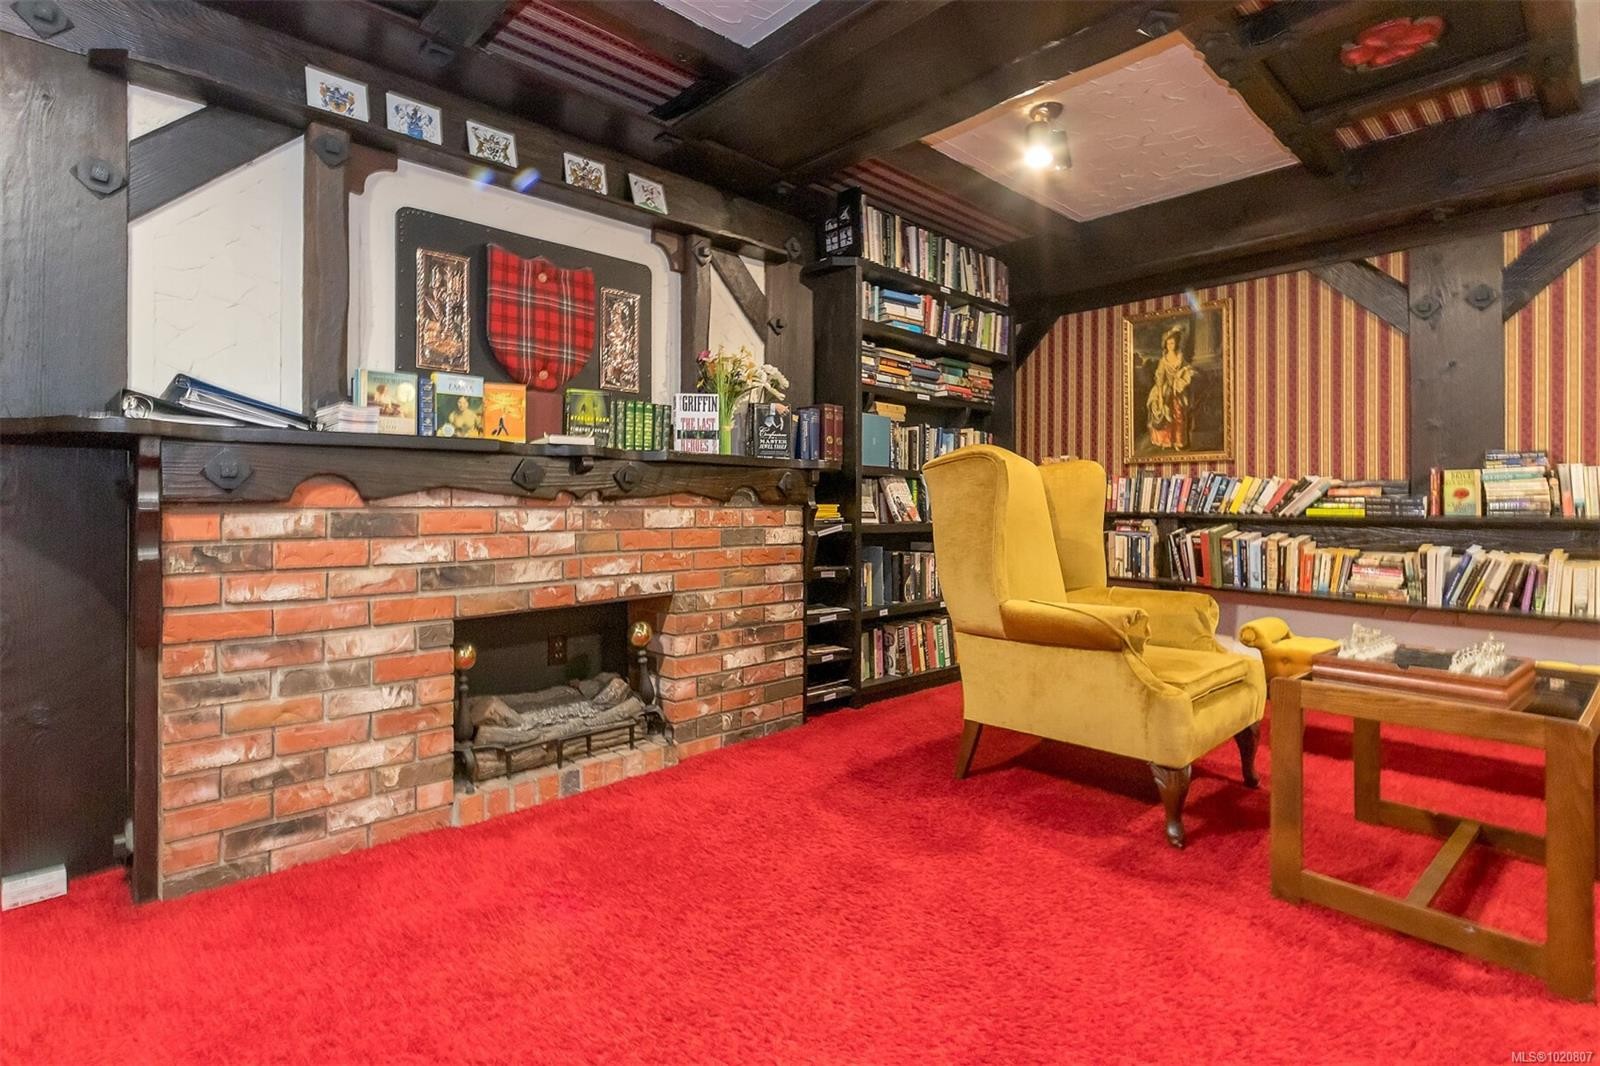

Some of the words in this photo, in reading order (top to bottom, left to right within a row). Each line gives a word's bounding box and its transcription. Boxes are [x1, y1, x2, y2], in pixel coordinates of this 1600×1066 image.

[682, 395, 718, 412] GRIFFIN
[681, 417, 696, 432] THE
[697, 417, 716, 432] LAST
